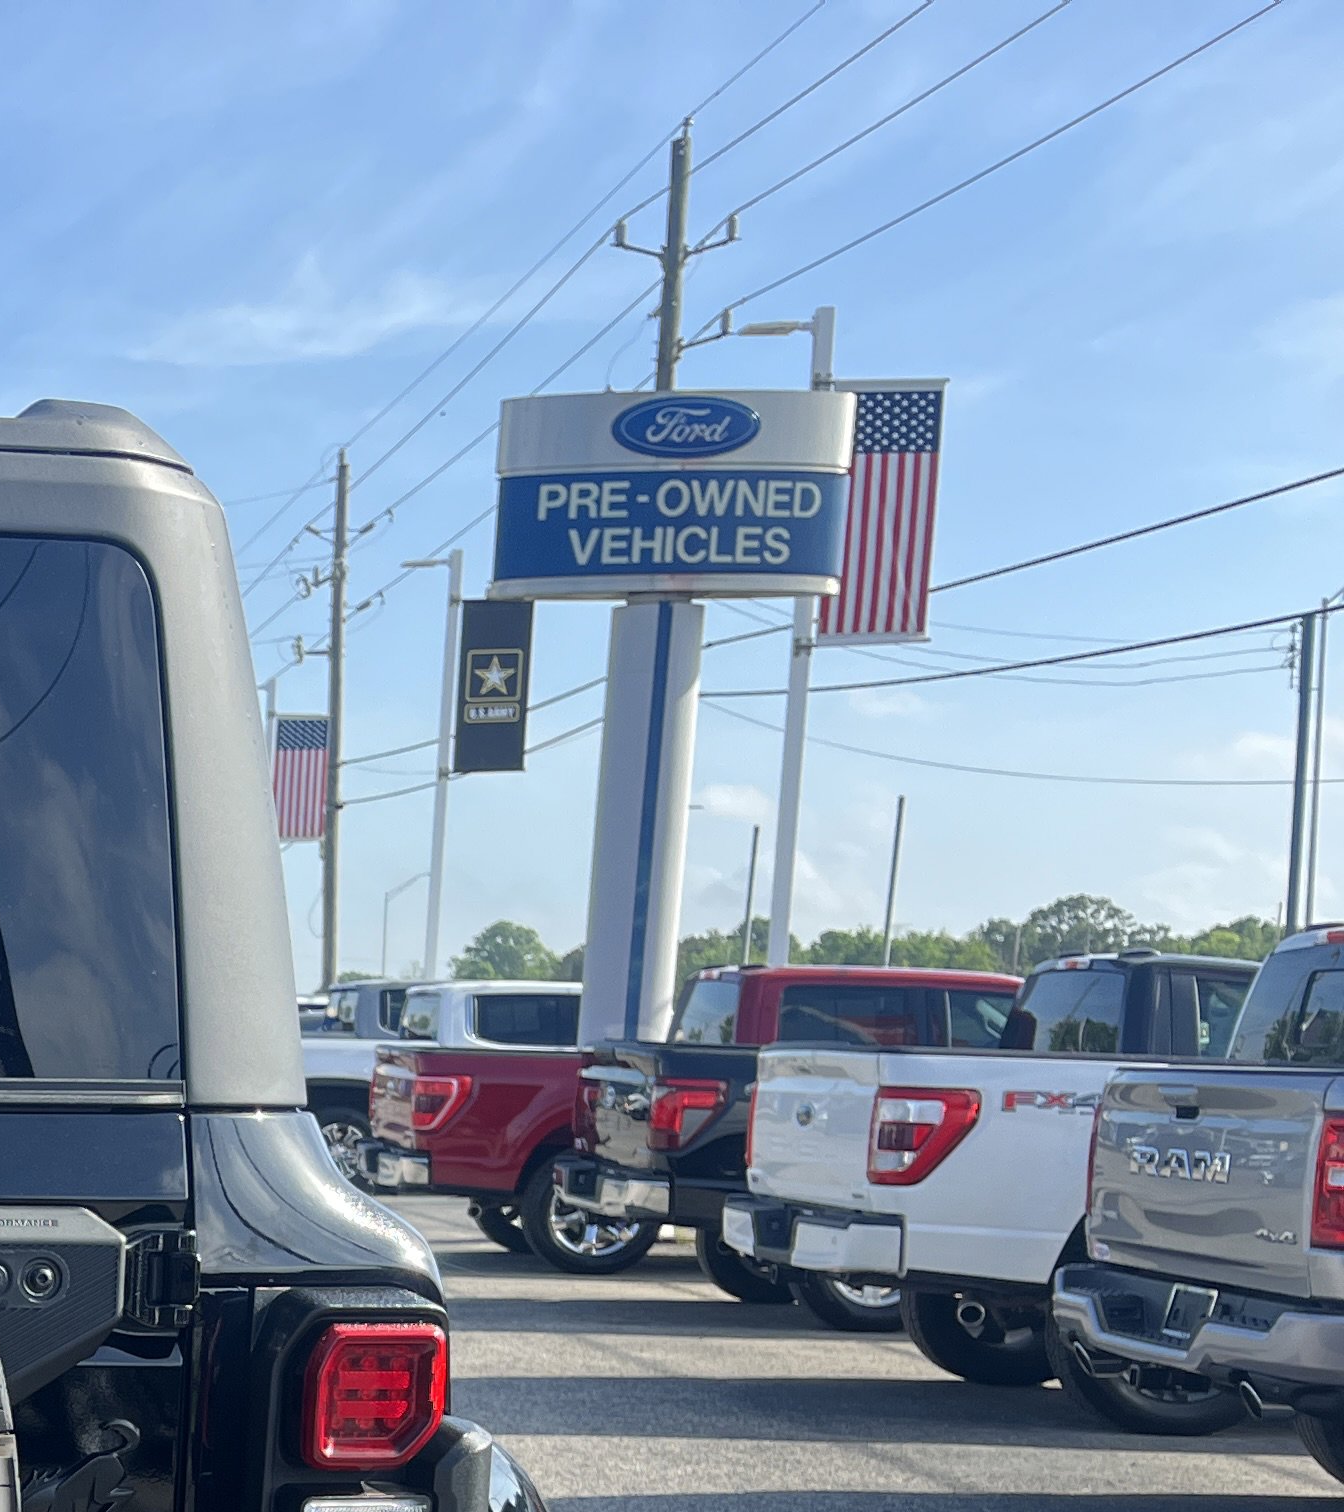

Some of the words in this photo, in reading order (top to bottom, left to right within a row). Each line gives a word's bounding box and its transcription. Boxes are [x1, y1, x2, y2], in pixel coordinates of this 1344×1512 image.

[645, 406, 731, 443] Ford
[537, 478, 823, 521] PRE-OWNED
[568, 526, 792, 566] VEHICLES
[1128, 1144, 1232, 1183] RAM
